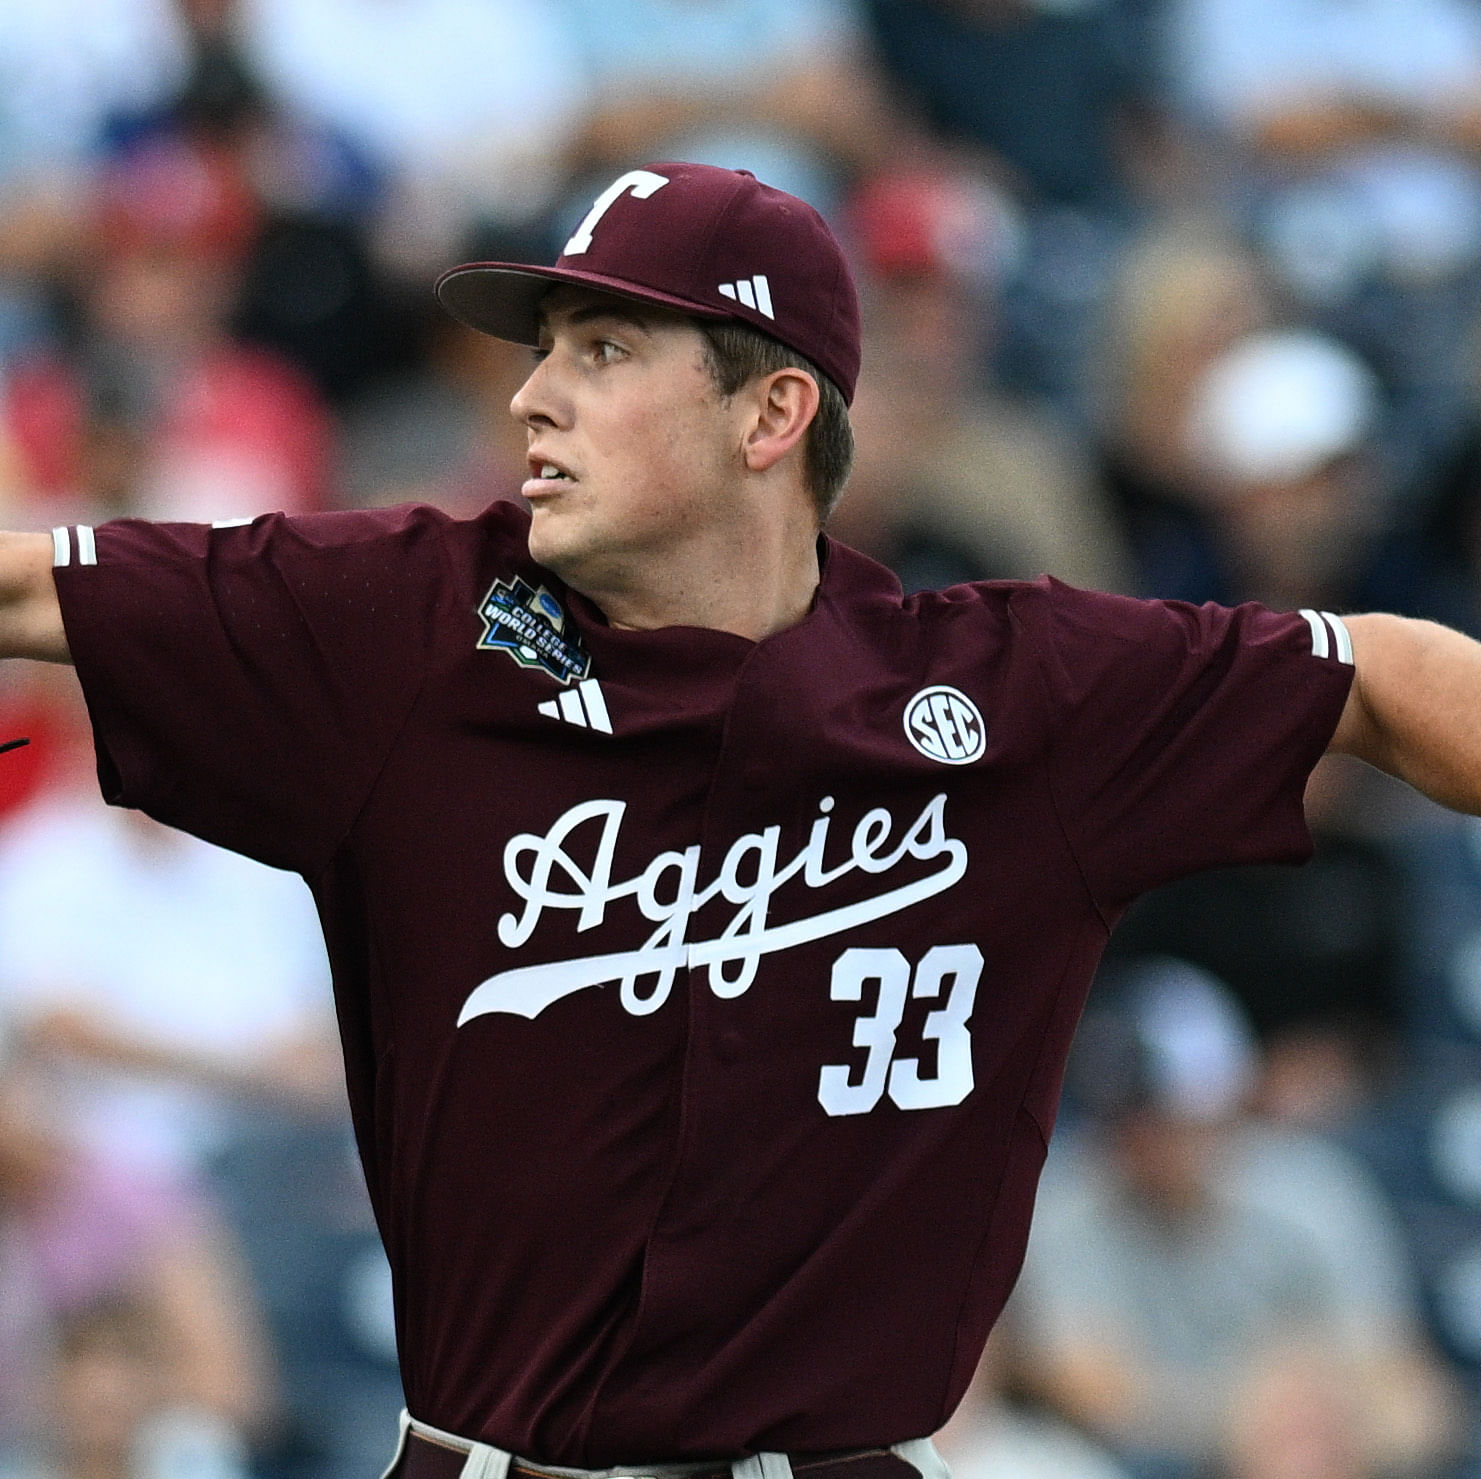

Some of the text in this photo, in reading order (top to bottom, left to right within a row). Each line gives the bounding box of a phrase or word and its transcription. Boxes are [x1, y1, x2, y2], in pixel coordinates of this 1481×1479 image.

[484, 603, 537, 640] WORLD
[536, 637, 583, 674] SERIES
[511, 606, 567, 652] COLLEGE
[911, 694, 979, 759] SEC
[498, 794, 952, 1016] Aggies
[818, 944, 984, 1117] 33
